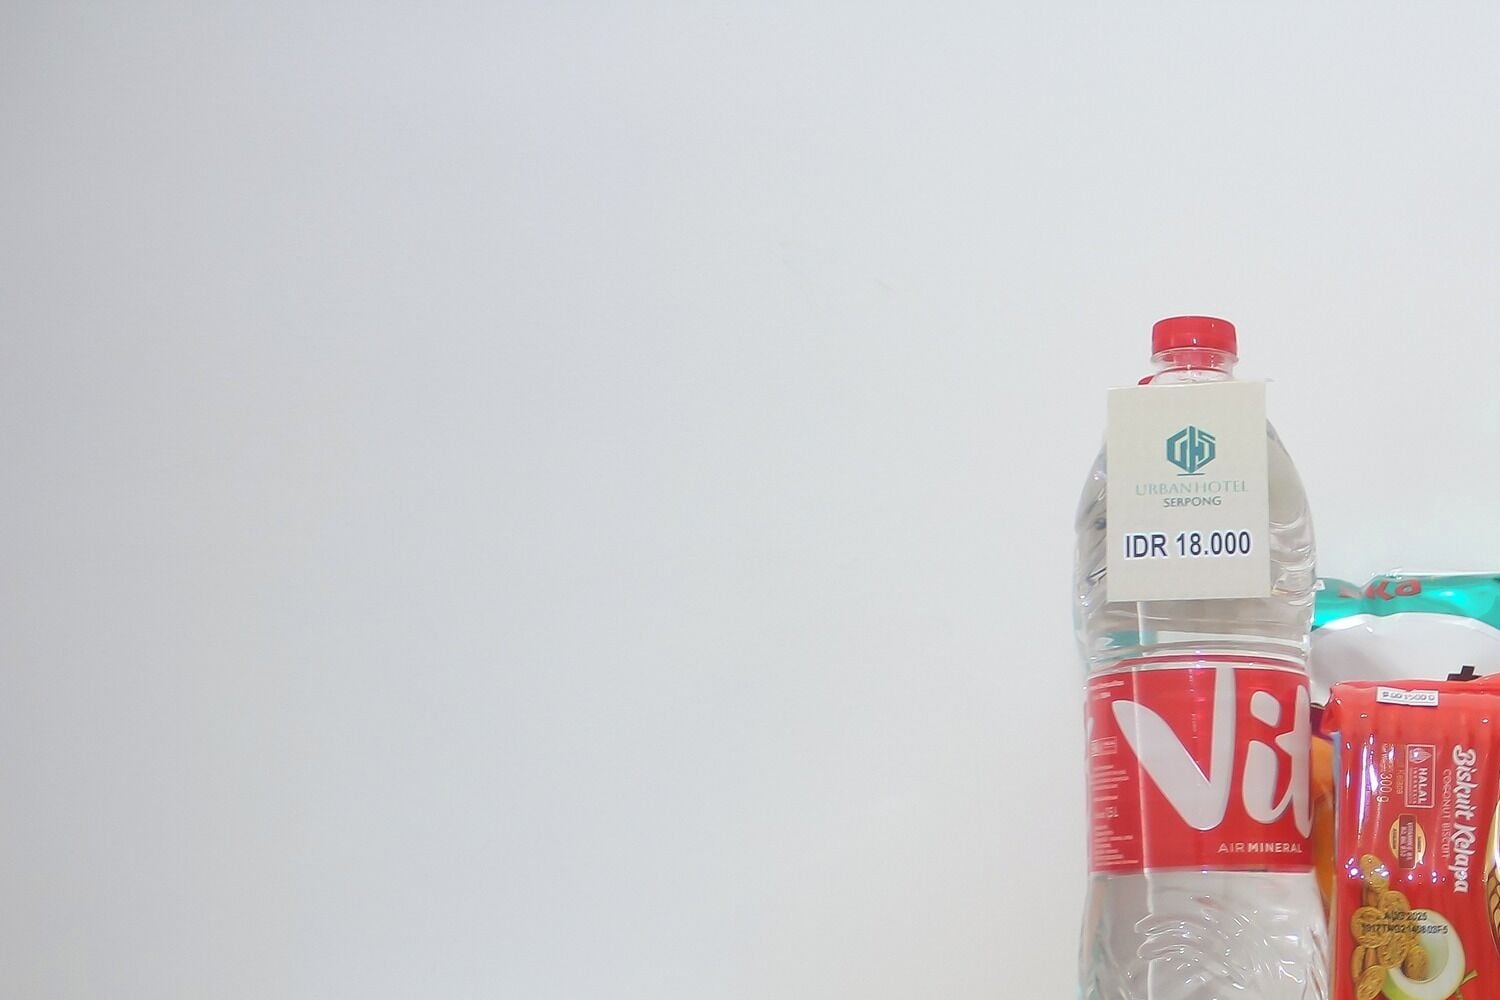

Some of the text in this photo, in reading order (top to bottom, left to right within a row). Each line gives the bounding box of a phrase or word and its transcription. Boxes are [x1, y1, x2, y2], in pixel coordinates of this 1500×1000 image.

[1163, 496, 1222, 508] SERPONG
[1125, 530, 1251, 558] IDR 18.000
[1379, 773, 1393, 793] 300
[1418, 767, 1428, 804] HALAL
[1441, 769, 1451, 859] COCONUT BISCUIT
[1448, 744, 1477, 894] Biskuit Kelapa
[1218, 842, 1303, 854] AIR MINERAL
